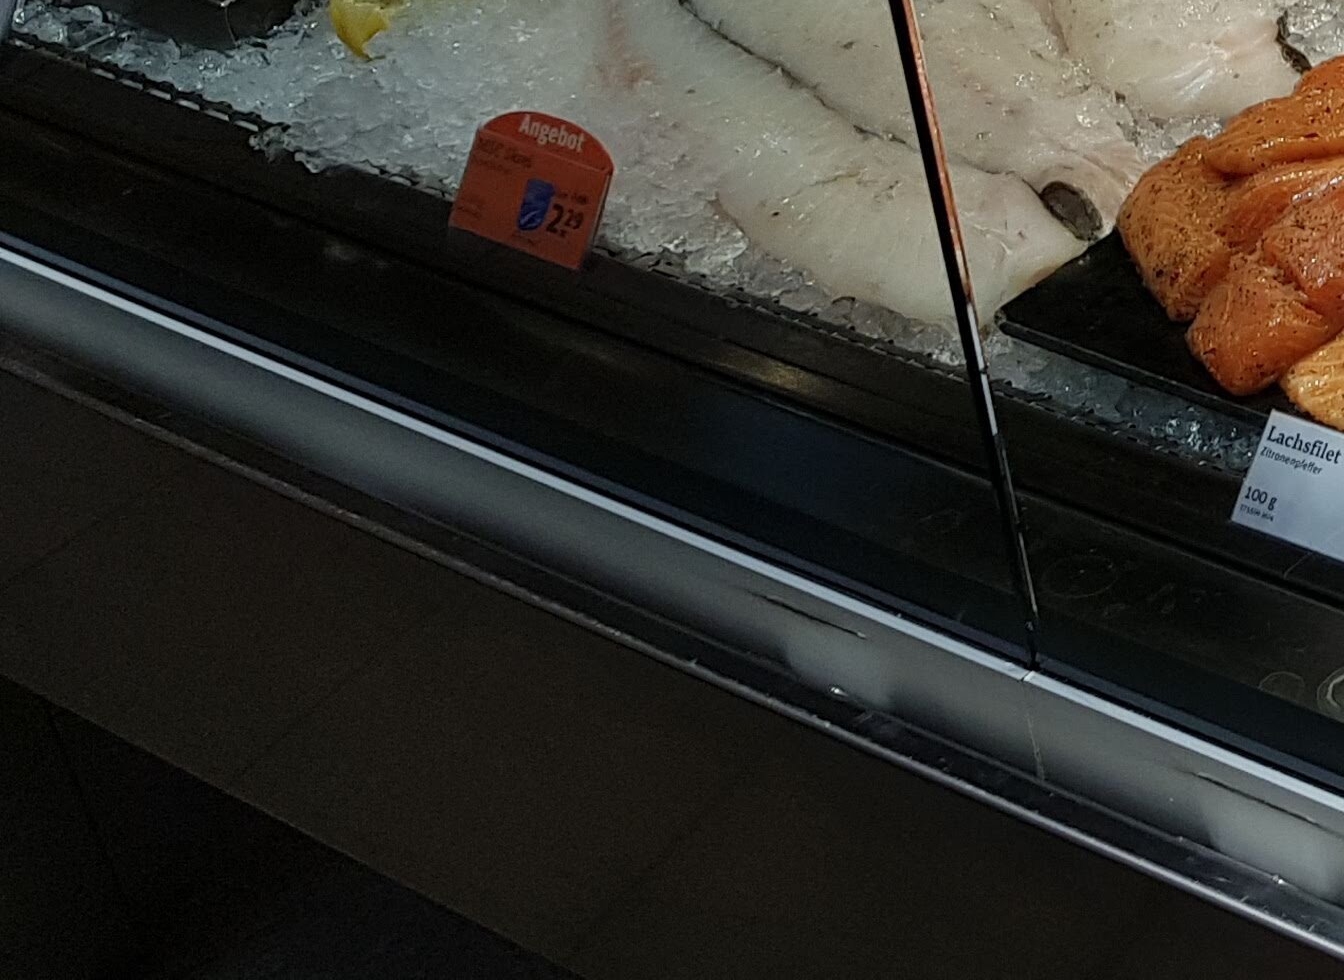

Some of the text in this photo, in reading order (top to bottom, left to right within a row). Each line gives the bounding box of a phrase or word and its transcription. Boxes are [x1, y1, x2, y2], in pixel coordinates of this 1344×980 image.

[518, 114, 585, 152] Angebot
[1266, 426, 1342, 464] Lachsfilet
[1244, 486, 1277, 511] 100 g
